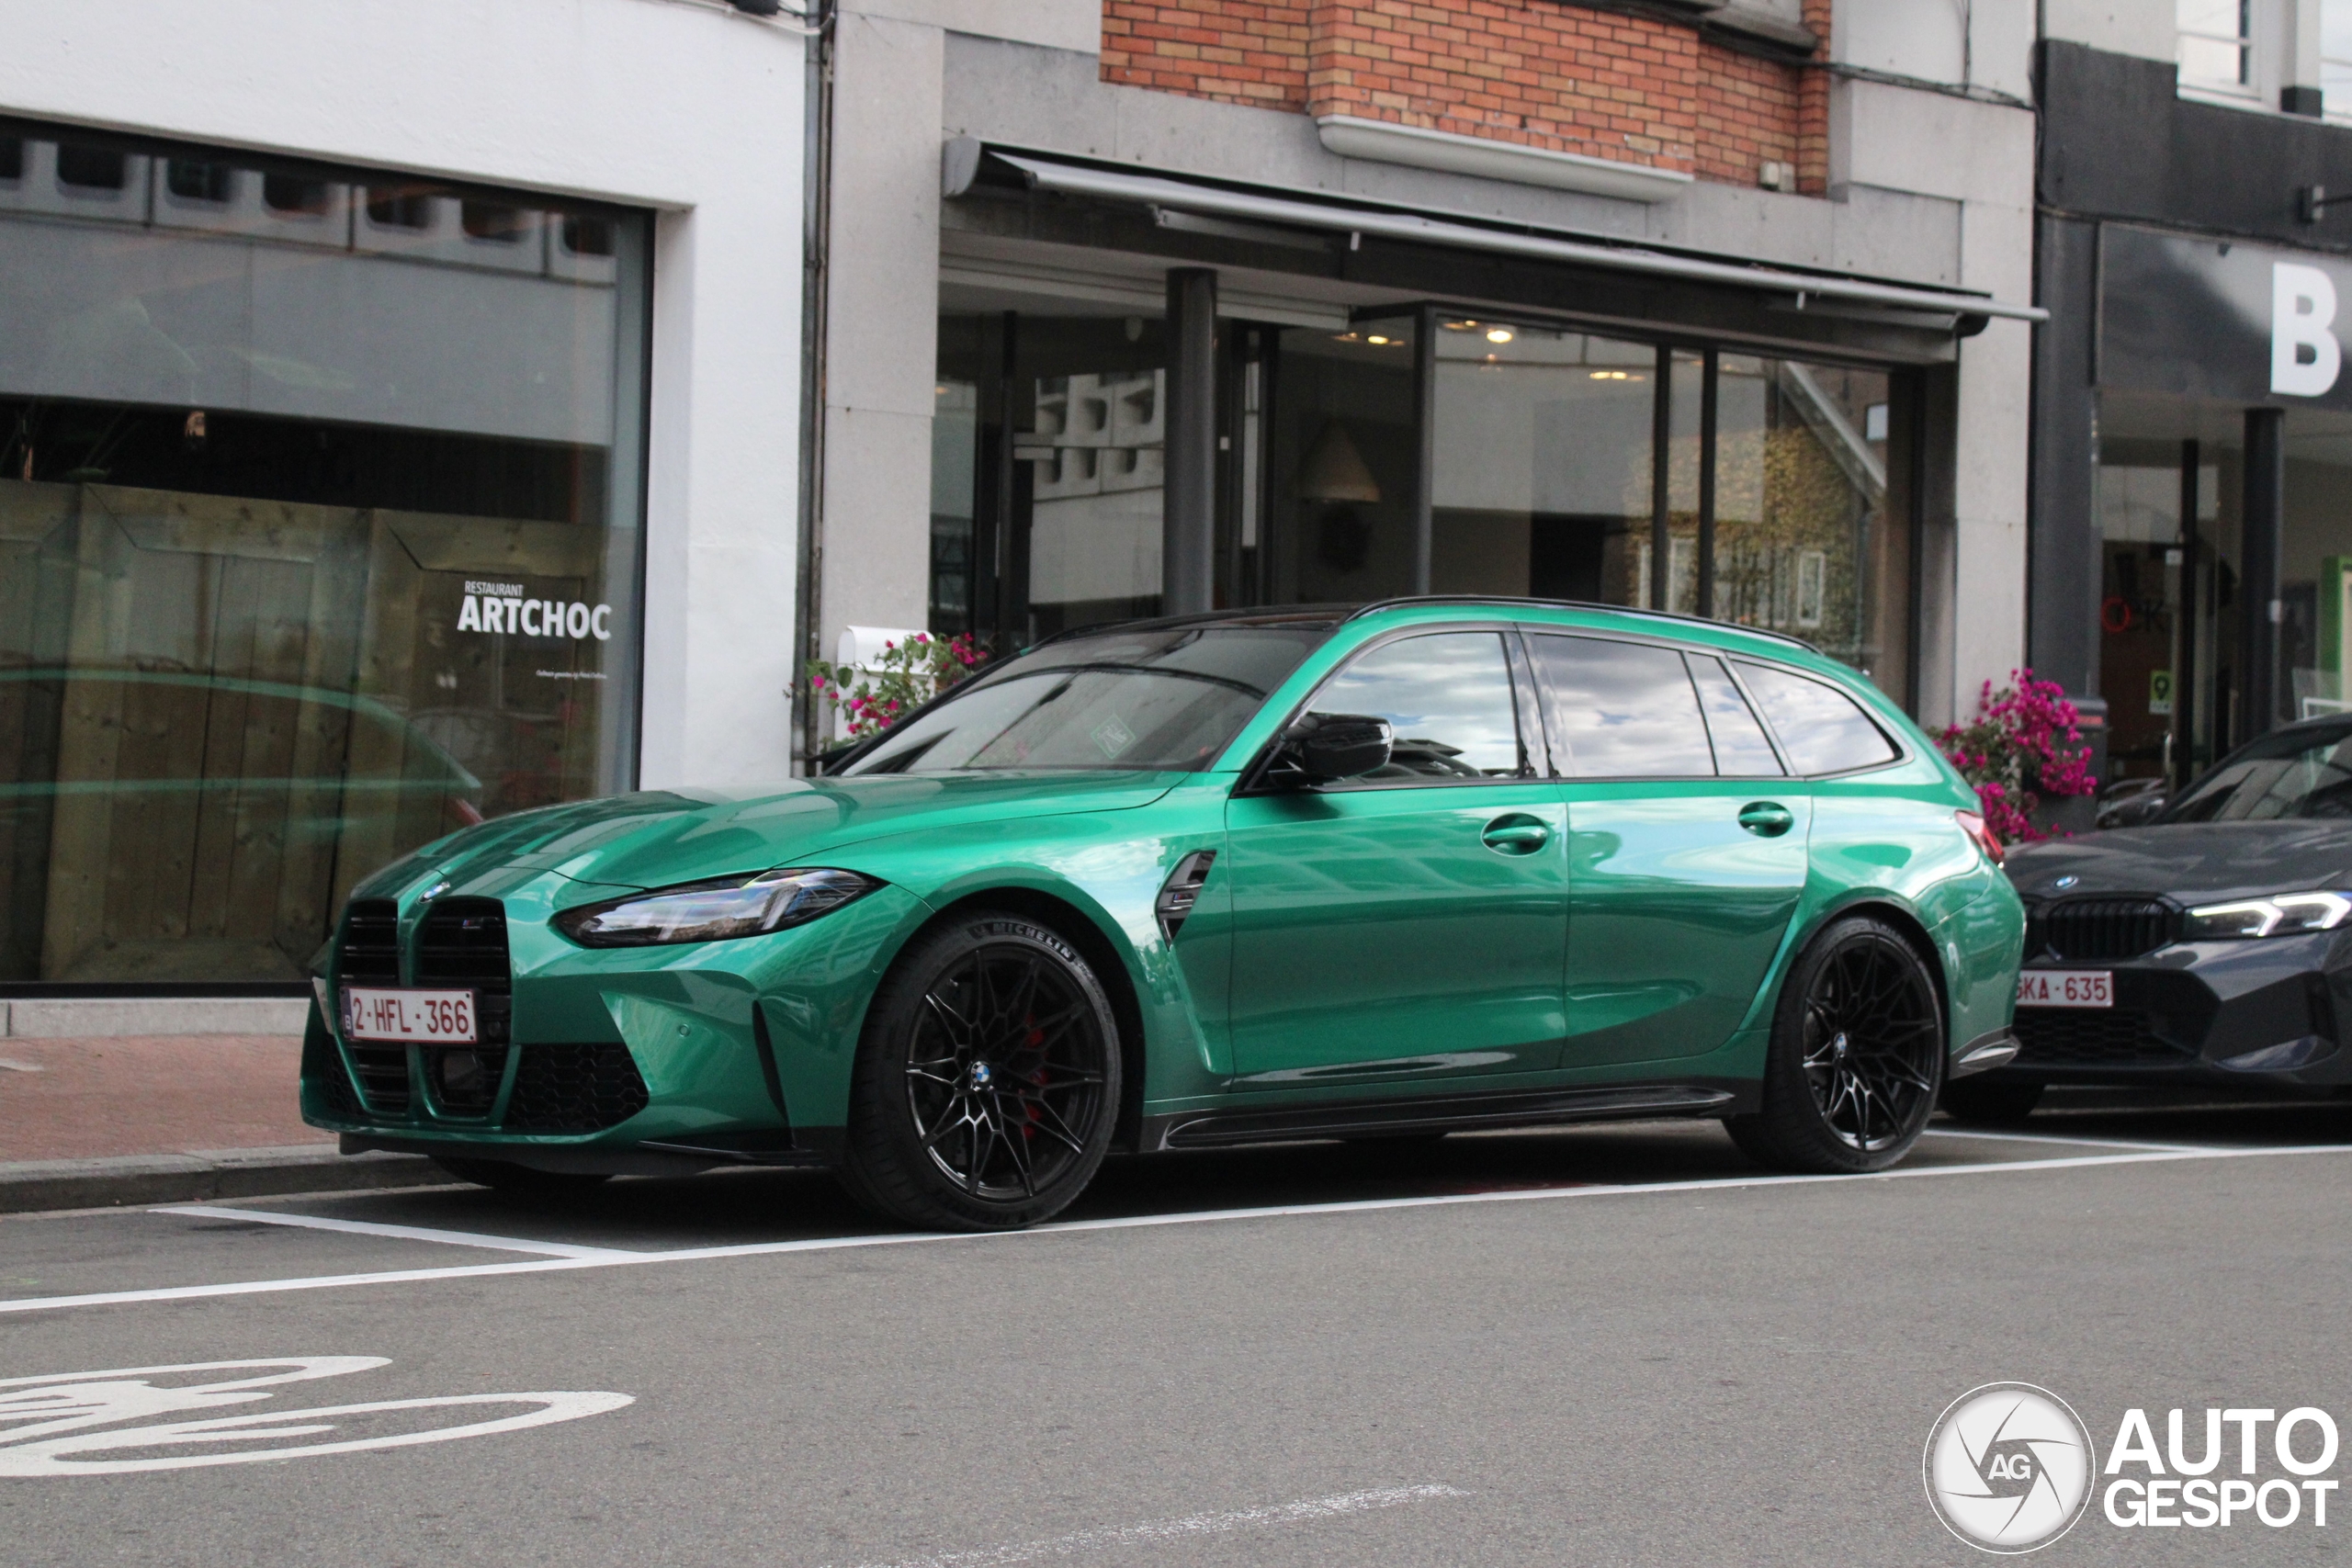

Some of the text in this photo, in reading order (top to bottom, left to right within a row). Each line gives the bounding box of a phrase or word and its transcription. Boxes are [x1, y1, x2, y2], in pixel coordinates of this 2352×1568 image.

[2270, 262, 2341, 397] B
[465, 580, 523, 596] RESTAURANT
[457, 595, 612, 640] ARTCHOC
[992, 923, 1073, 959] MICHELIN
